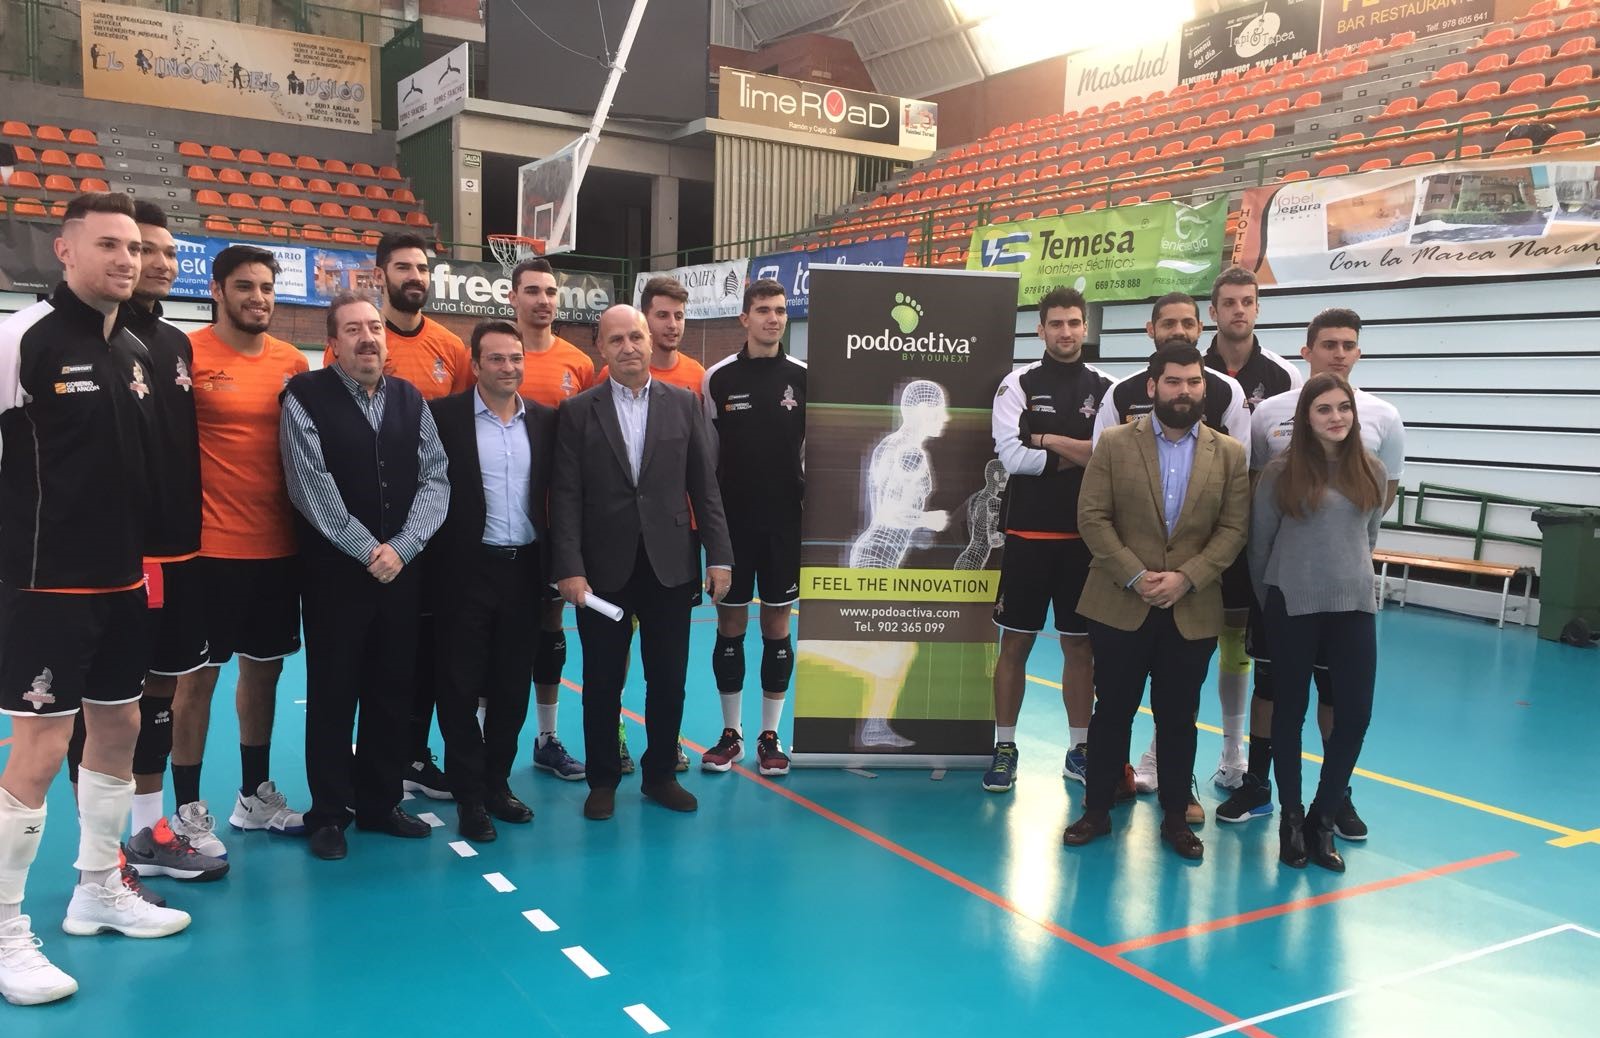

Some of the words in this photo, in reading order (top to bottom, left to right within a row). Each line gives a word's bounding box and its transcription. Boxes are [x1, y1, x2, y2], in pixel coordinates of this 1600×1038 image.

[1336, 15, 1365, 34] BAR
[1442, 18, 1456, 29] 978
[732, 71, 796, 114] Time
[1038, 230, 1135, 261] Temesa
[1232, 208, 1251, 265] HOTEL
[1329, 252, 1371, 272] Con
[1379, 247, 1403, 267] la
[1507, 239, 1600, 267] Naran
[170, 287, 194, 295] MIDAS
[432, 302, 457, 312] una
[460, 303, 495, 315] forma
[498, 305, 515, 317] de
[572, 311, 583, 321] la
[901, 353, 916, 362] BY
[919, 354, 971, 364] YOUNEXT
[812, 576, 852, 591] FEEL
[857, 578, 888, 592] THE
[892, 578, 989, 594] INNOVATION
[839, 606, 960, 620] www.podoactiva.com
[854, 621, 874, 633] Tel.
[877, 622, 898, 633] 902
[900, 622, 922, 633] 365
[924, 622, 945, 633] 099
